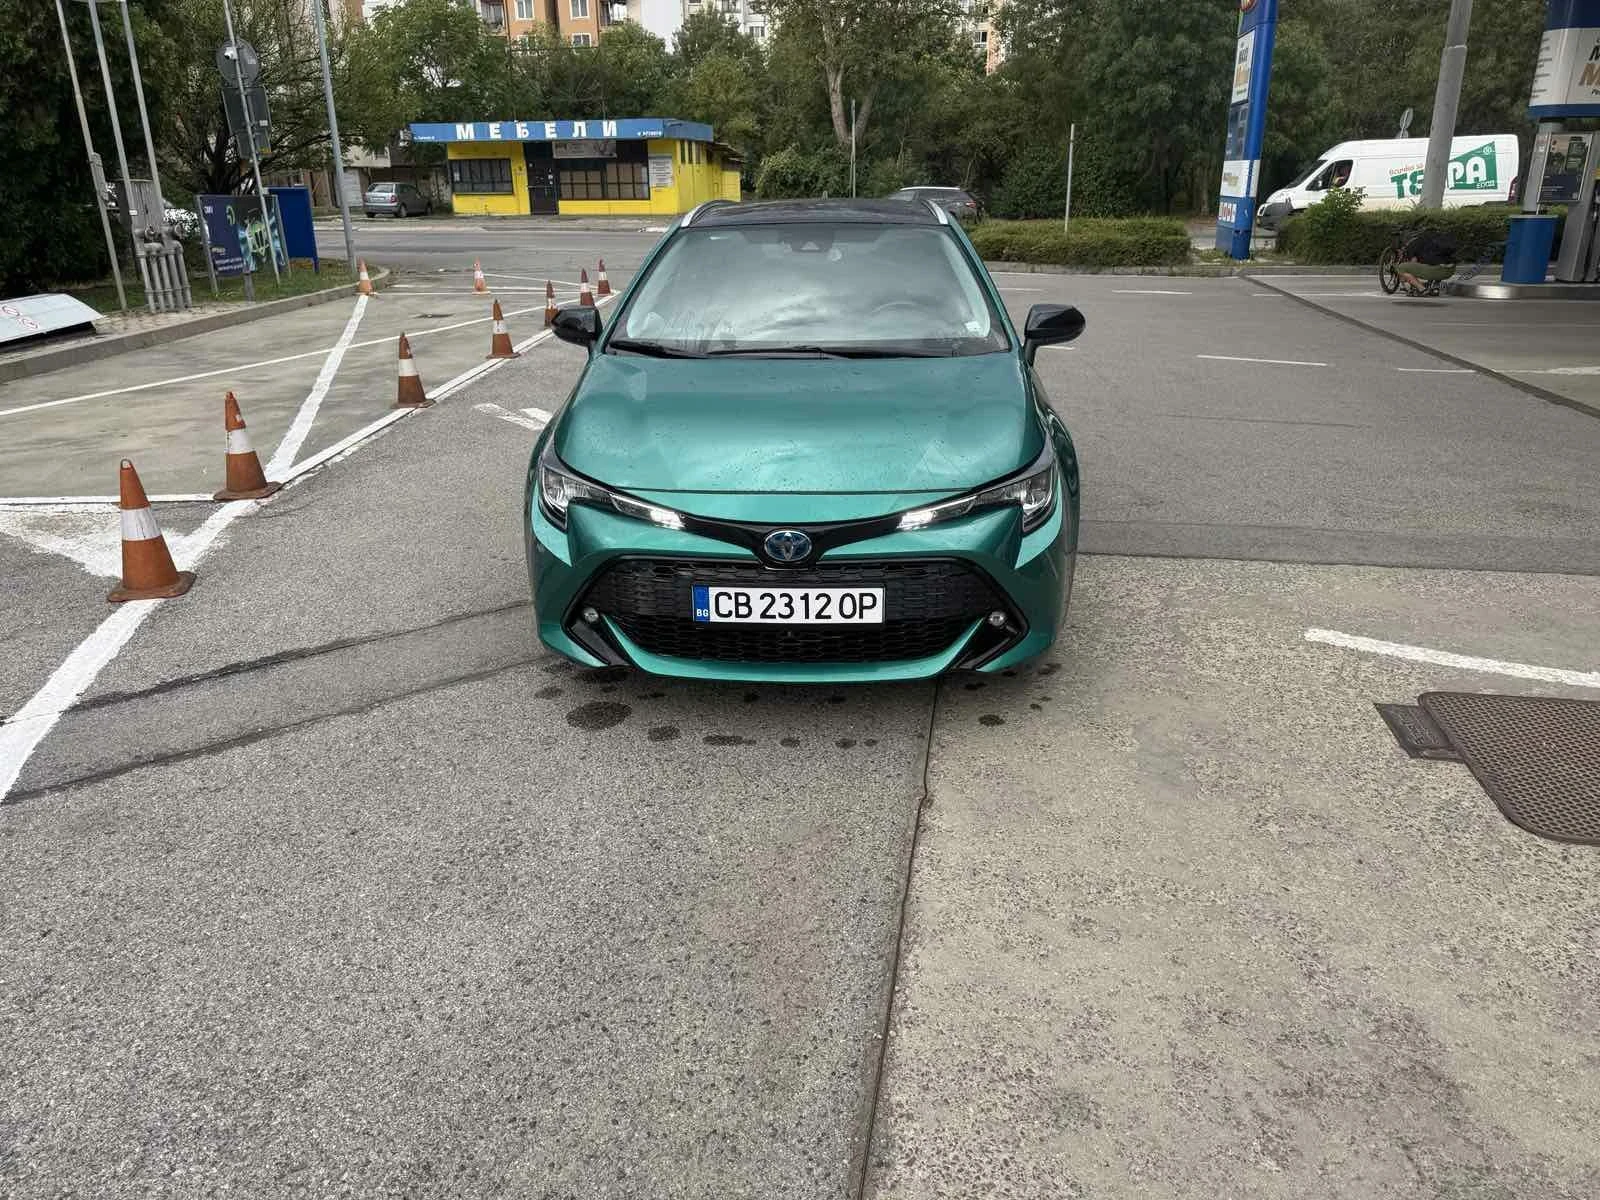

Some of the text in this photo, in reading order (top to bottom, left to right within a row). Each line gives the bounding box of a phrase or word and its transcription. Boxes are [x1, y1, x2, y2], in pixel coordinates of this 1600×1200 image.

[457, 121, 618, 140] МЕБЕЛИ
[696, 609, 709, 617] BG
[714, 592, 877, 620] CB 2312 OP
